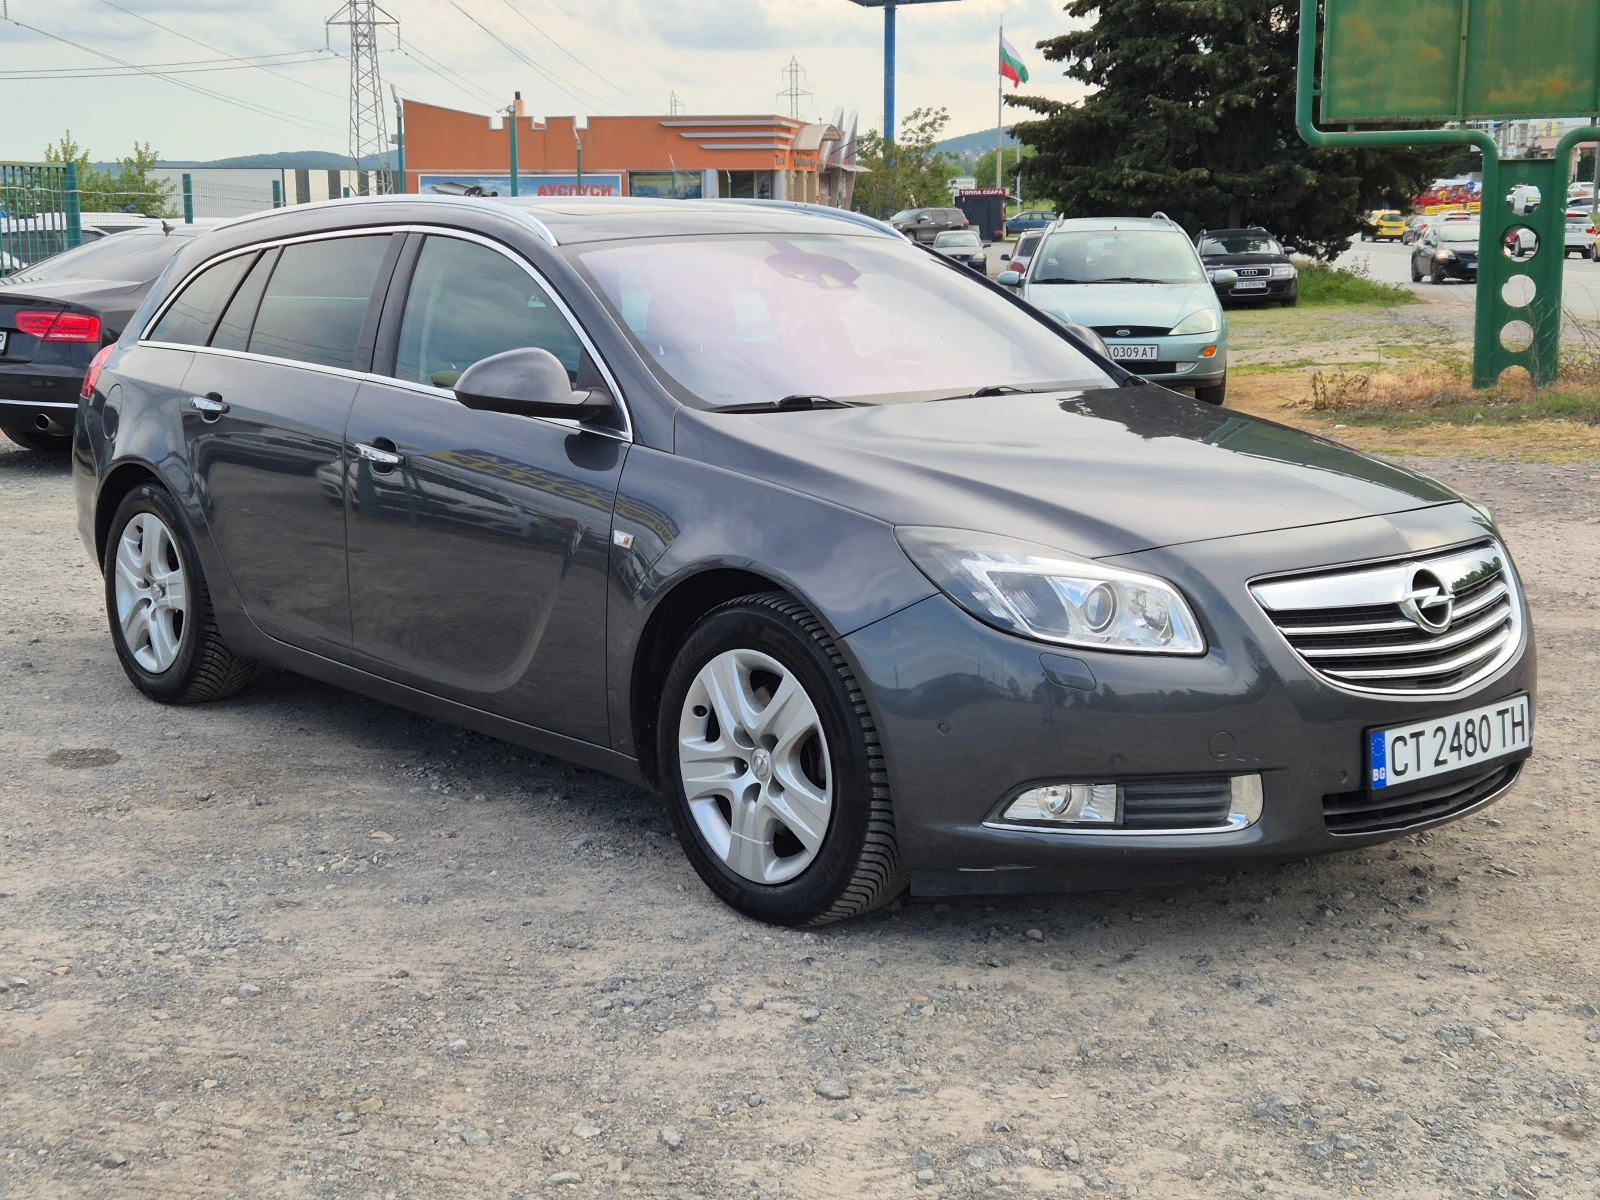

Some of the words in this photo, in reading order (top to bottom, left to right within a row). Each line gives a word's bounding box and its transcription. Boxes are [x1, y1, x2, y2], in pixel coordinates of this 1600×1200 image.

[537, 184, 612, 197] АУСПУСИ
[1113, 347, 1139, 358] 0309
[1141, 347, 1156, 358] AT
[1391, 729, 1426, 777] CT
[1432, 714, 1492, 768] 2480
[1496, 703, 1526, 749] TH
[1372, 766, 1386, 782] BG
